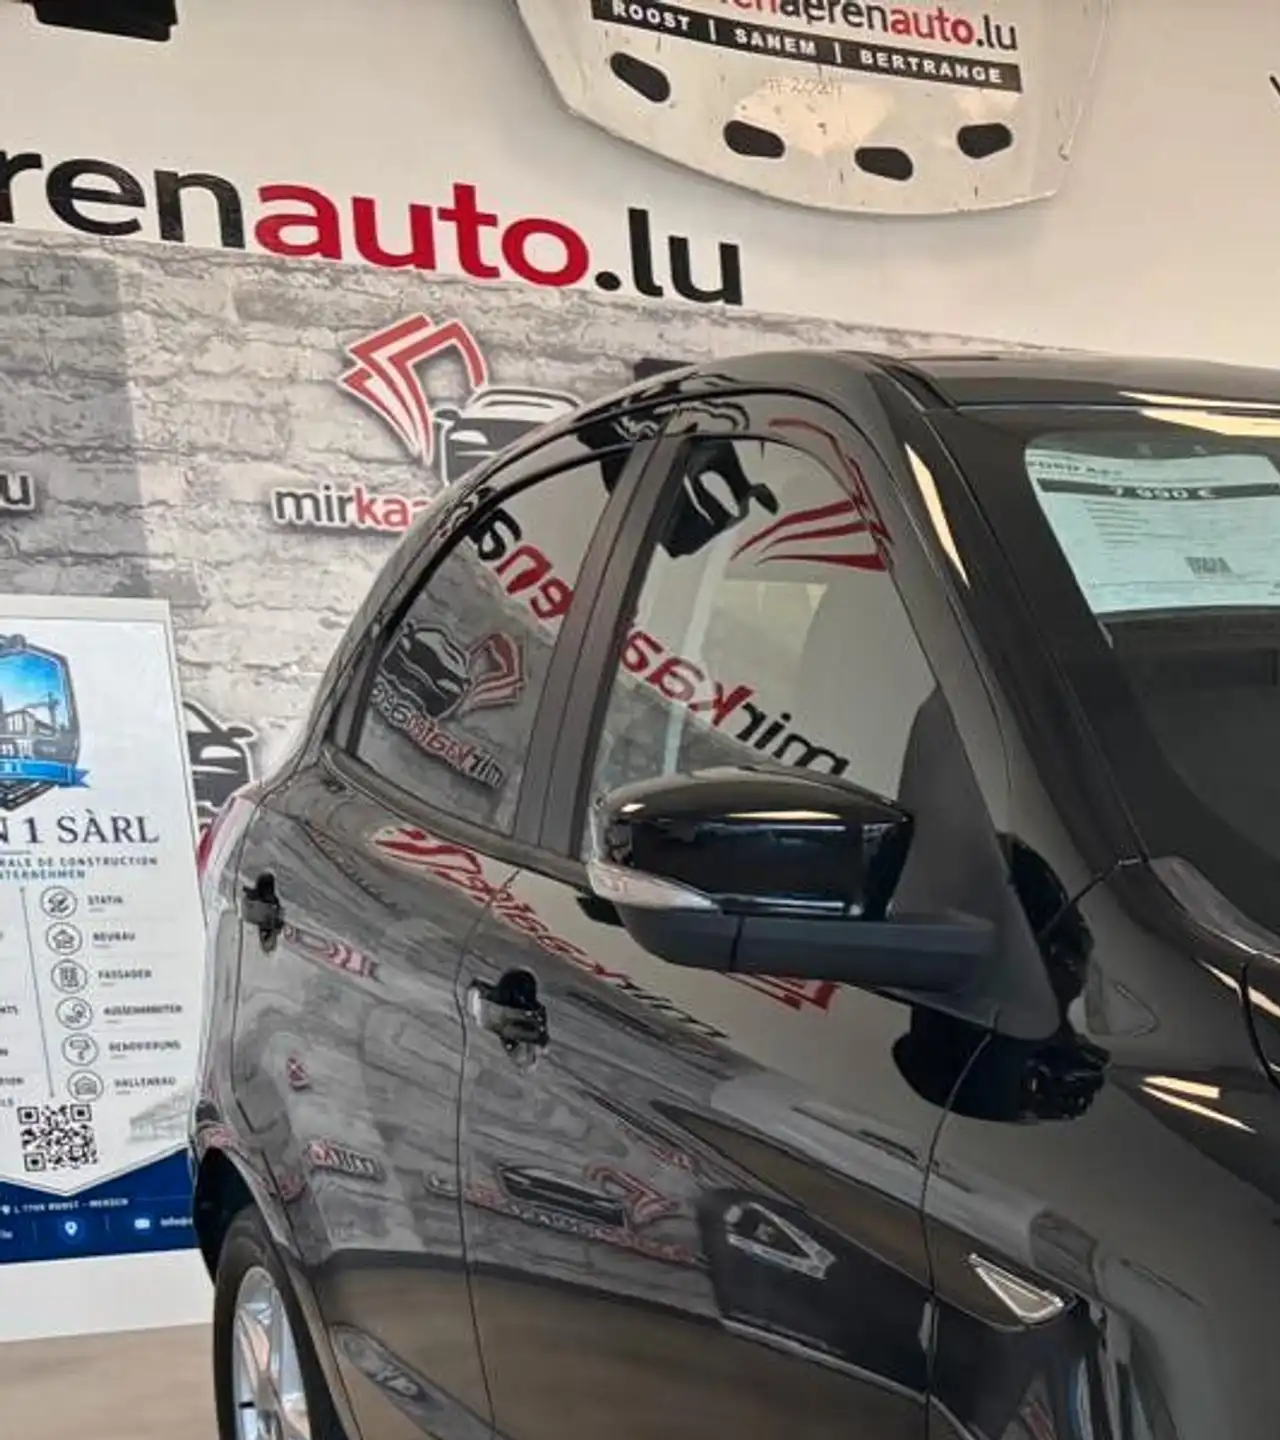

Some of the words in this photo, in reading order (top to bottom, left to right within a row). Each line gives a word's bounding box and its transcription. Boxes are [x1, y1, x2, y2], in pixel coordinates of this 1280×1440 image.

[612, 0, 691, 31] ROOST
[734, 27, 817, 57] SANEM
[859, 50, 1002, 84] BERTRANGE
[275, 484, 429, 527] mirka
[56, 808, 160, 844] SÀRL
[60, 855, 158, 867] CONSTRUCTION
